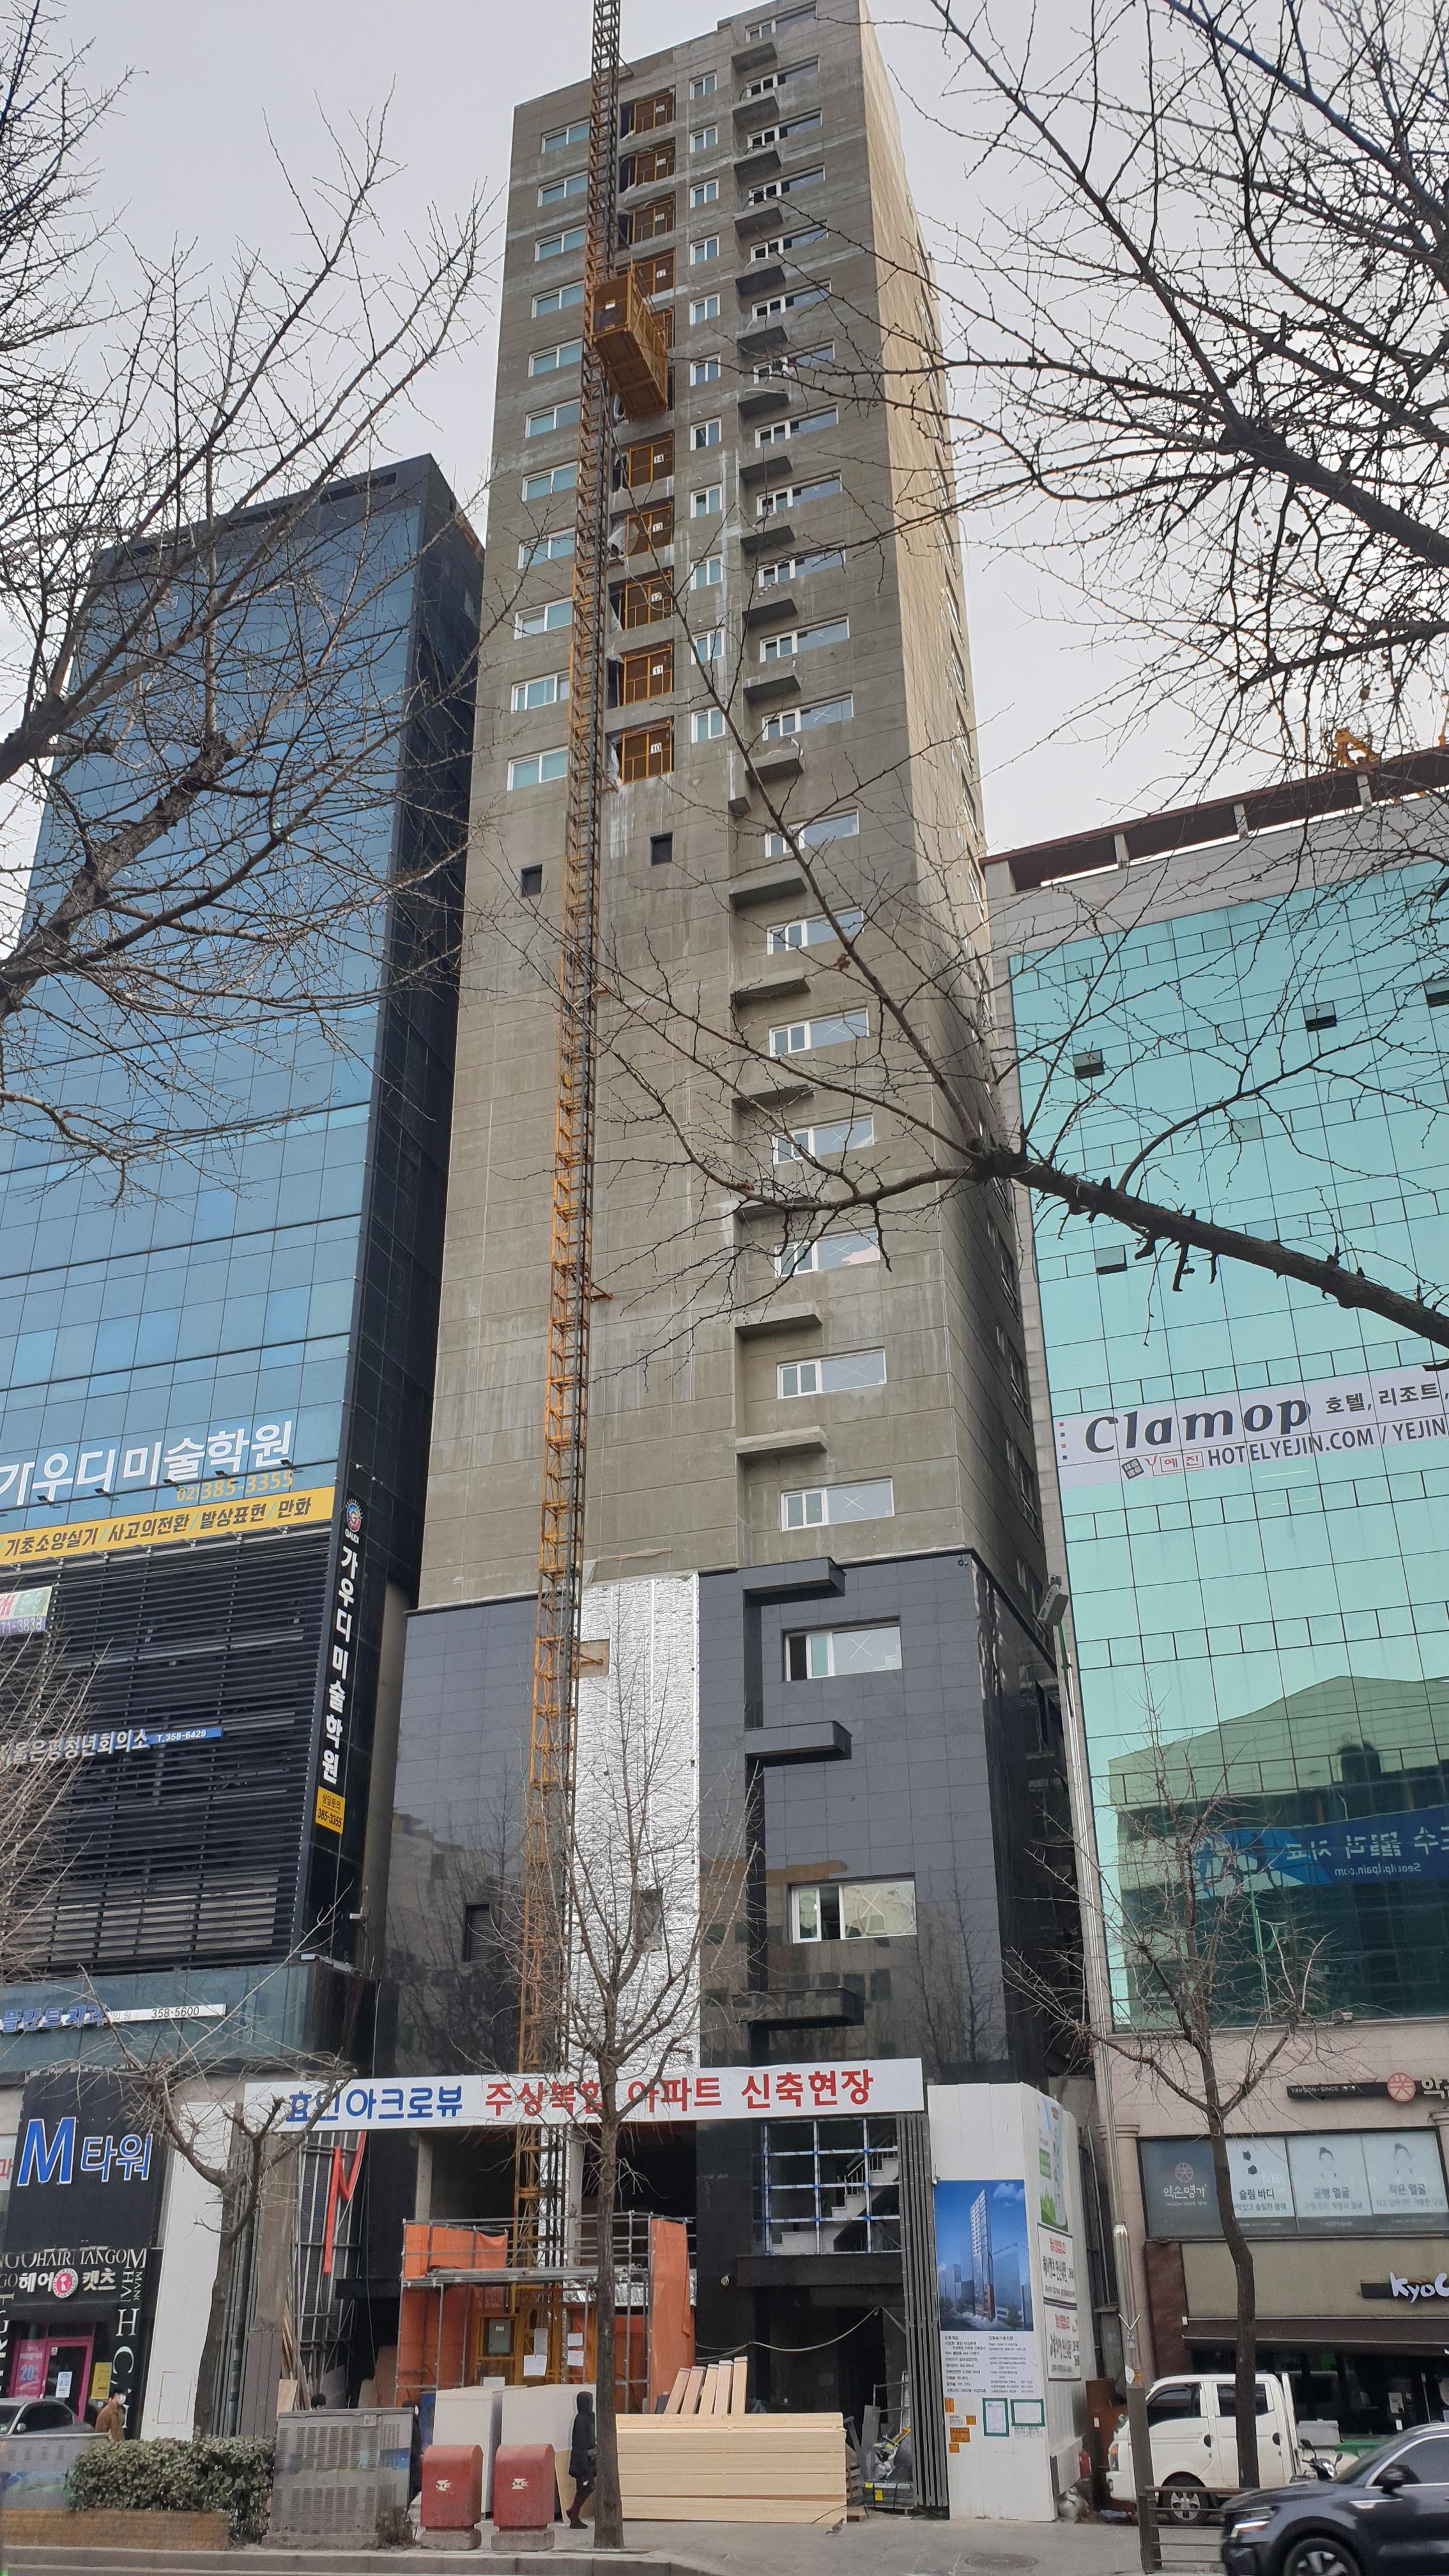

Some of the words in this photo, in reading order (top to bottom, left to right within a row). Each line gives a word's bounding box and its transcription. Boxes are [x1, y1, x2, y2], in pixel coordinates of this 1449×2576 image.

[1325, 1393, 1372, 1414] 호텔,
[1379, 1383, 1448, 1406] 리조트,
[1085, 1397, 1311, 1453] Clamop
[1208, 1428, 1374, 1467] HOTELYEJIN.COM
[0, 1421, 292, 1506] 가우디미술학원
[176, 1469, 294, 1502] 02)385-3355
[4, 1528, 99, 1557] 기초소양실기
[107, 1514, 190, 1543] 사고의전환
[200, 1503, 267, 1530] 발상표현
[278, 1497, 312, 1519] 만화
[345, 1528, 360, 1545] GAUDI
[322, 1545, 358, 1784] 가우디미술학원
[157, 1729, 206, 1742] T.358-6429
[321, 1793, 341, 1811] 상담문의
[318, 1808, 342, 1828] 385-3355
[151, 2005, 200, 2019] 358-5600
[627, 2076, 723, 2113] 아파트
[741, 2068, 874, 2110] 신축현장
[17, 2116, 77, 2187] M
[80, 2133, 153, 2182] 타워
[1163, 2184, 1206, 2199] 약손명가
[1239, 2189, 1256, 2201] 슬림
[1258, 2187, 1275, 2200] 바디
[1331, 2186, 1350, 2199] 얼굴
[1408, 2182, 1427, 2195] 얼굴
[19, 2273, 55, 2293] 헤어
[82, 2267, 116, 2292] 캣츠
